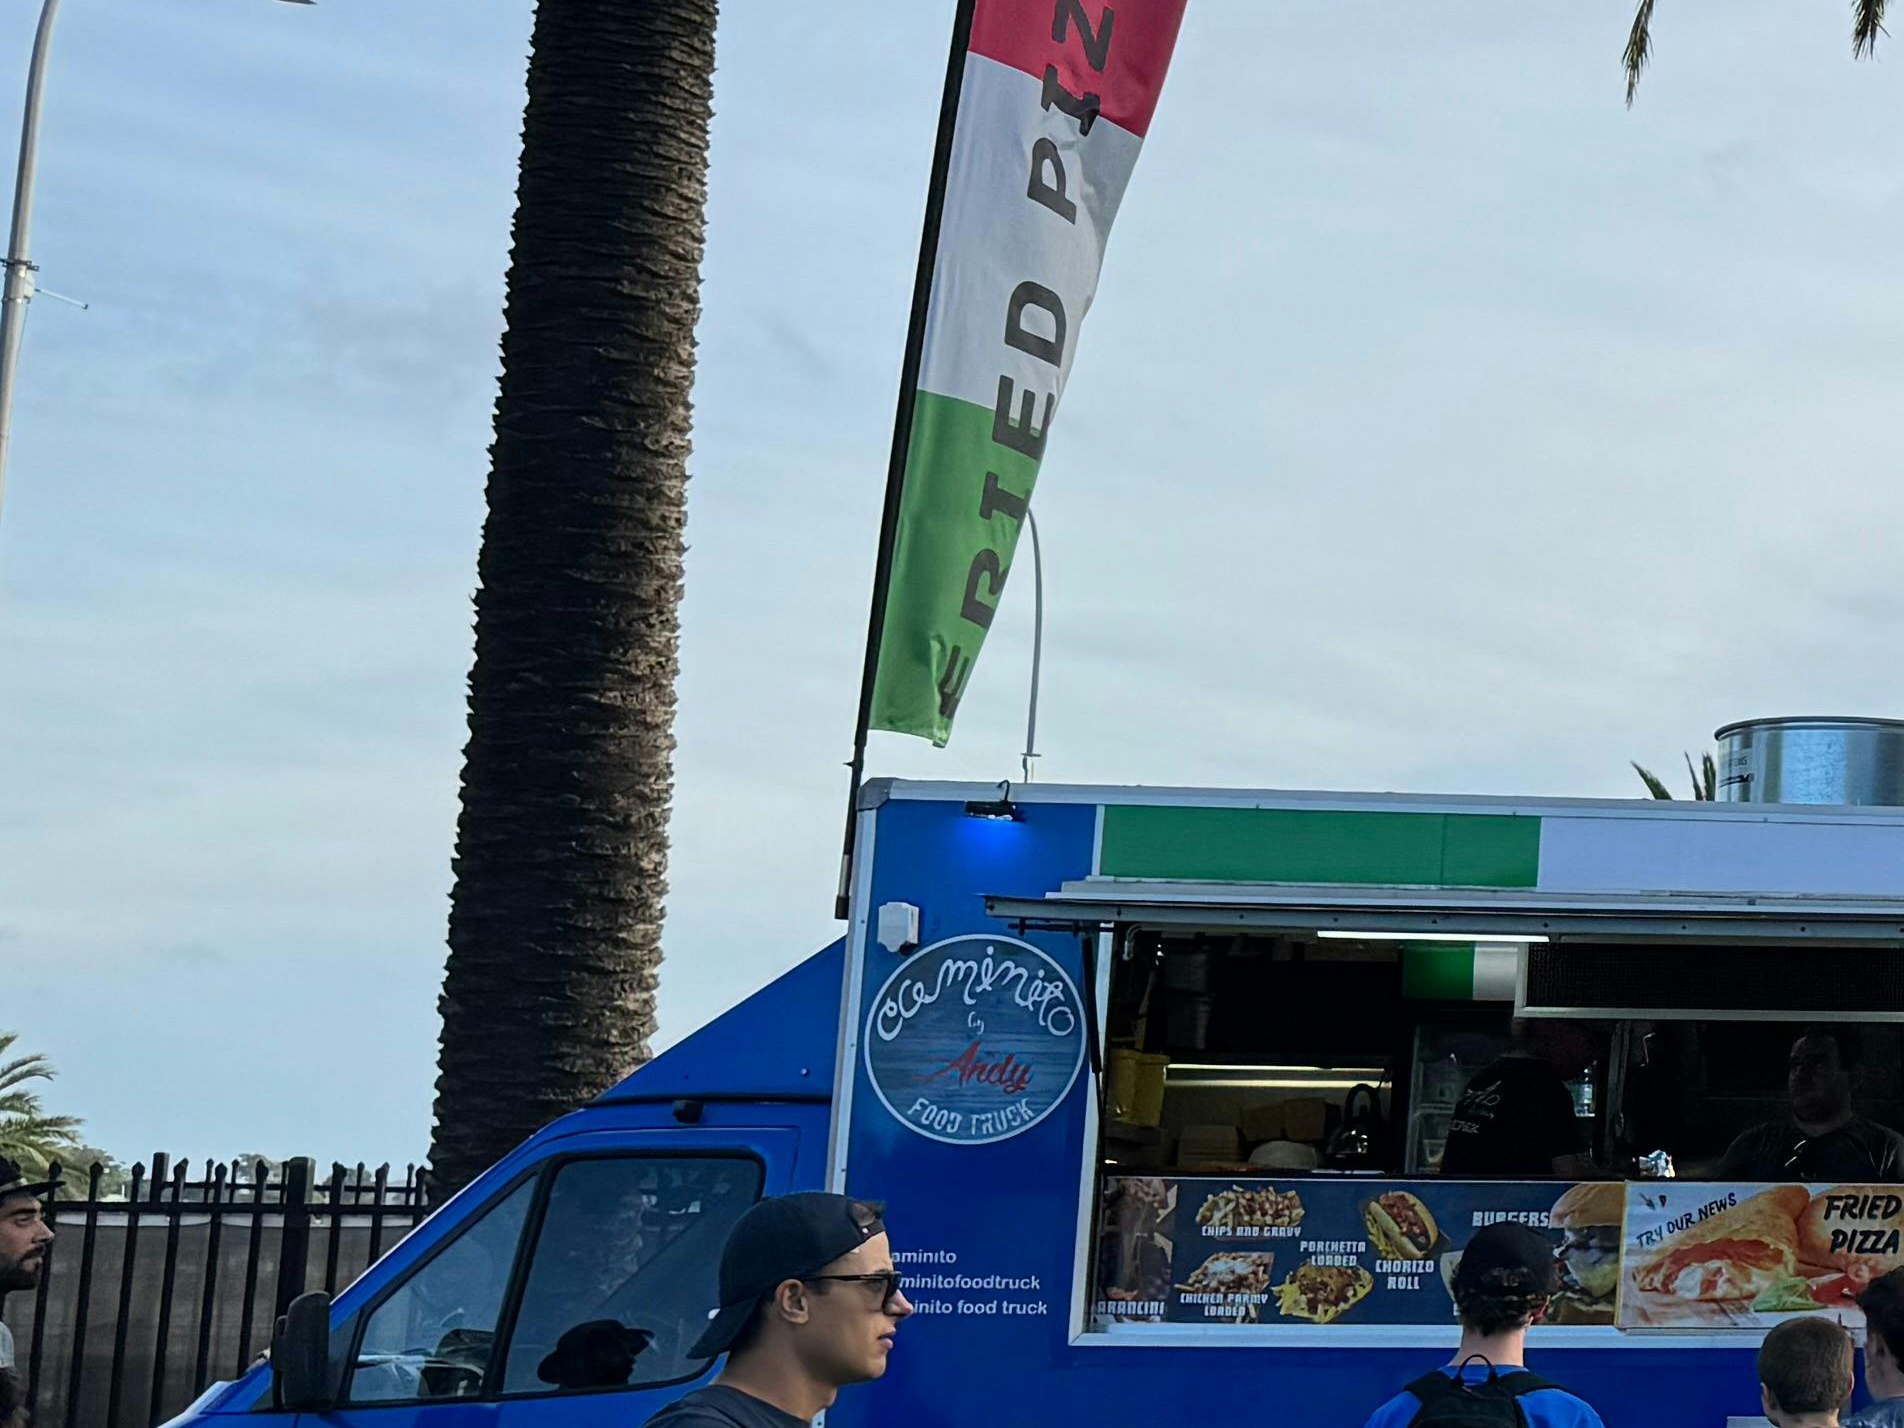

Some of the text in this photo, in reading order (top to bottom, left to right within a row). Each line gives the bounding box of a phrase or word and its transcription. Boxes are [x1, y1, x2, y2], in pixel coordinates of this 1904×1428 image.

[912, 1039, 1033, 1095] Andy
[907, 1097, 1036, 1135] FOOD TRUCK
[1823, 1194, 1904, 1221] FRIED
[1636, 1192, 1738, 1249] TRY OUR NEWS
[1201, 1225, 1232, 1237] CHIPS
[1235, 1226, 1259, 1237] AND
[1300, 1241, 1366, 1253] PORCHETTA
[1830, 1228, 1901, 1255] PIZZA
[891, 1248, 957, 1264] aminito
[1375, 1259, 1435, 1273] CHORIZO
[899, 1274, 1041, 1290] minitofoodtruck
[1387, 1276, 1420, 1290] ROLL
[912, 1299, 1048, 1315] inito food truck
[1098, 1301, 1165, 1315] ARANCINI
